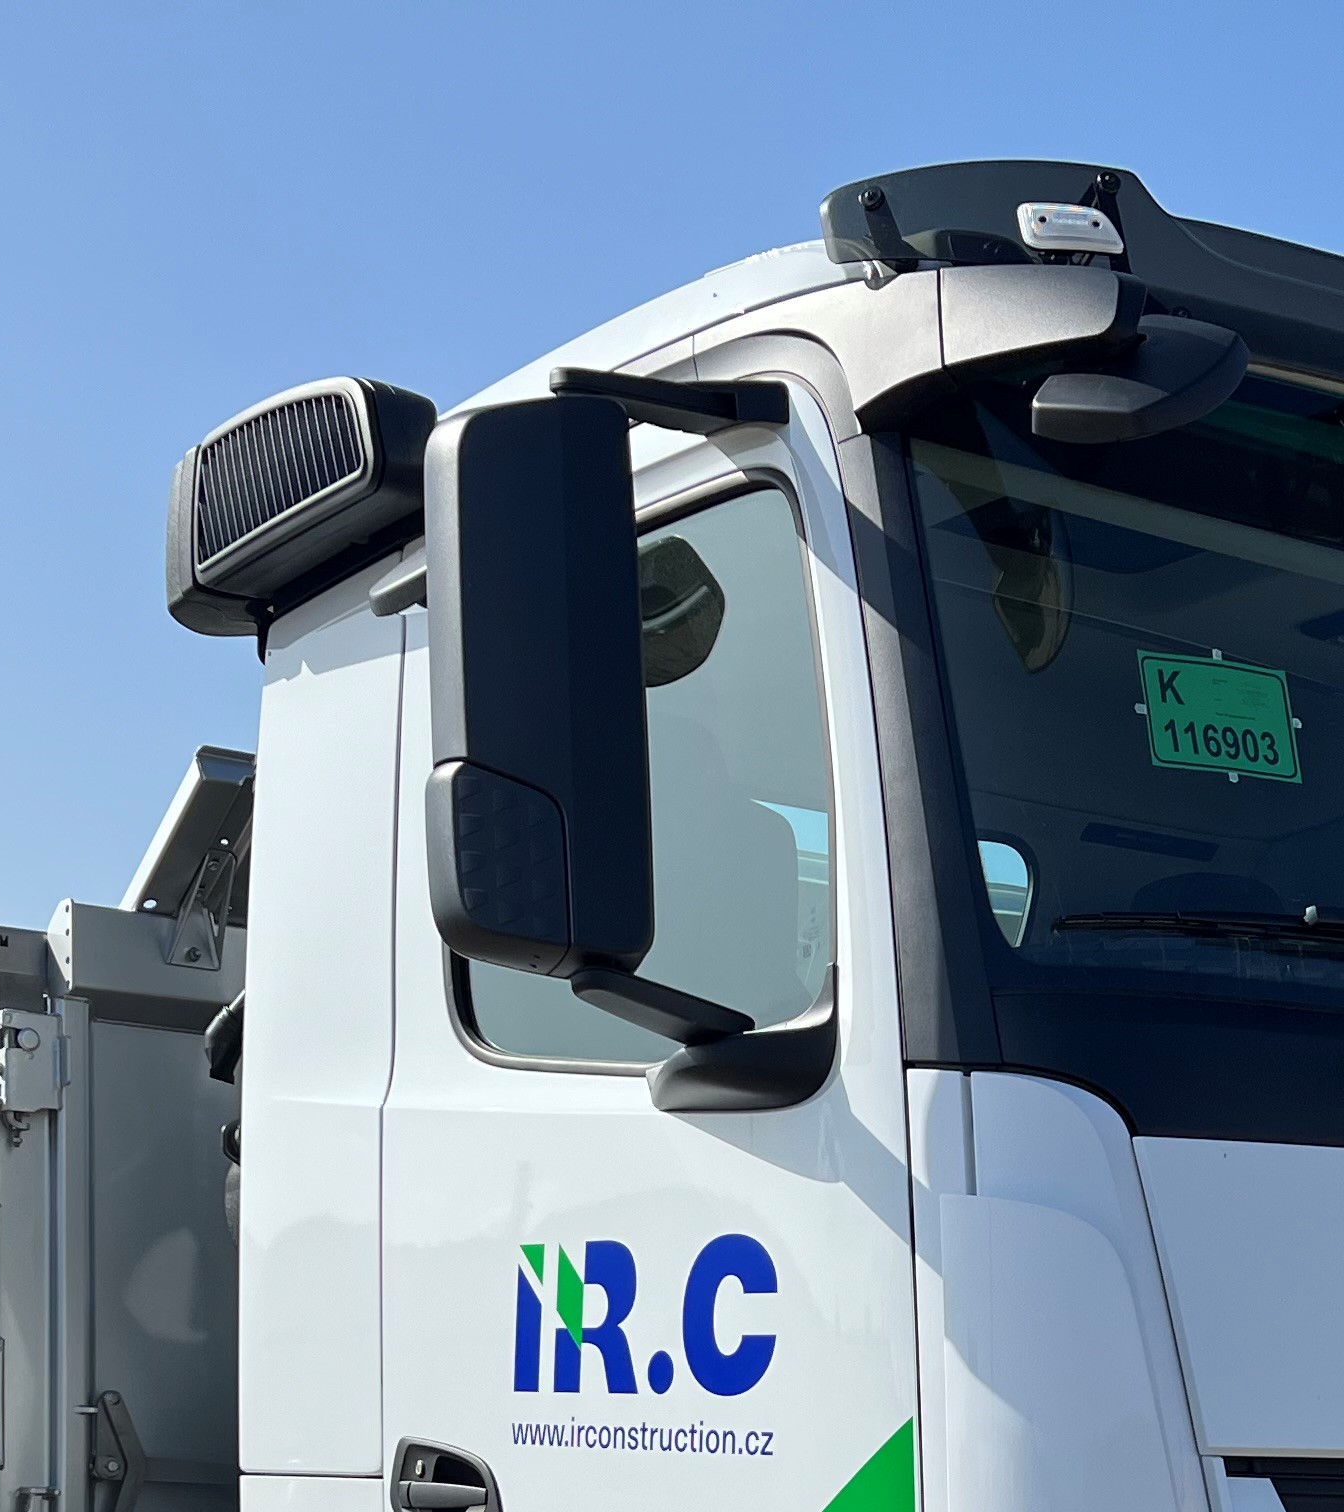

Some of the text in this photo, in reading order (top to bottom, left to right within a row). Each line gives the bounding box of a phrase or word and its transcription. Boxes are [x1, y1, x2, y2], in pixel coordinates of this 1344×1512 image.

[1157, 668, 1185, 706] K
[1164, 718, 1280, 766] 116903
[513, 1233, 778, 1397] IR.C
[511, 1416, 774, 1457] www.irconstruction.cz
